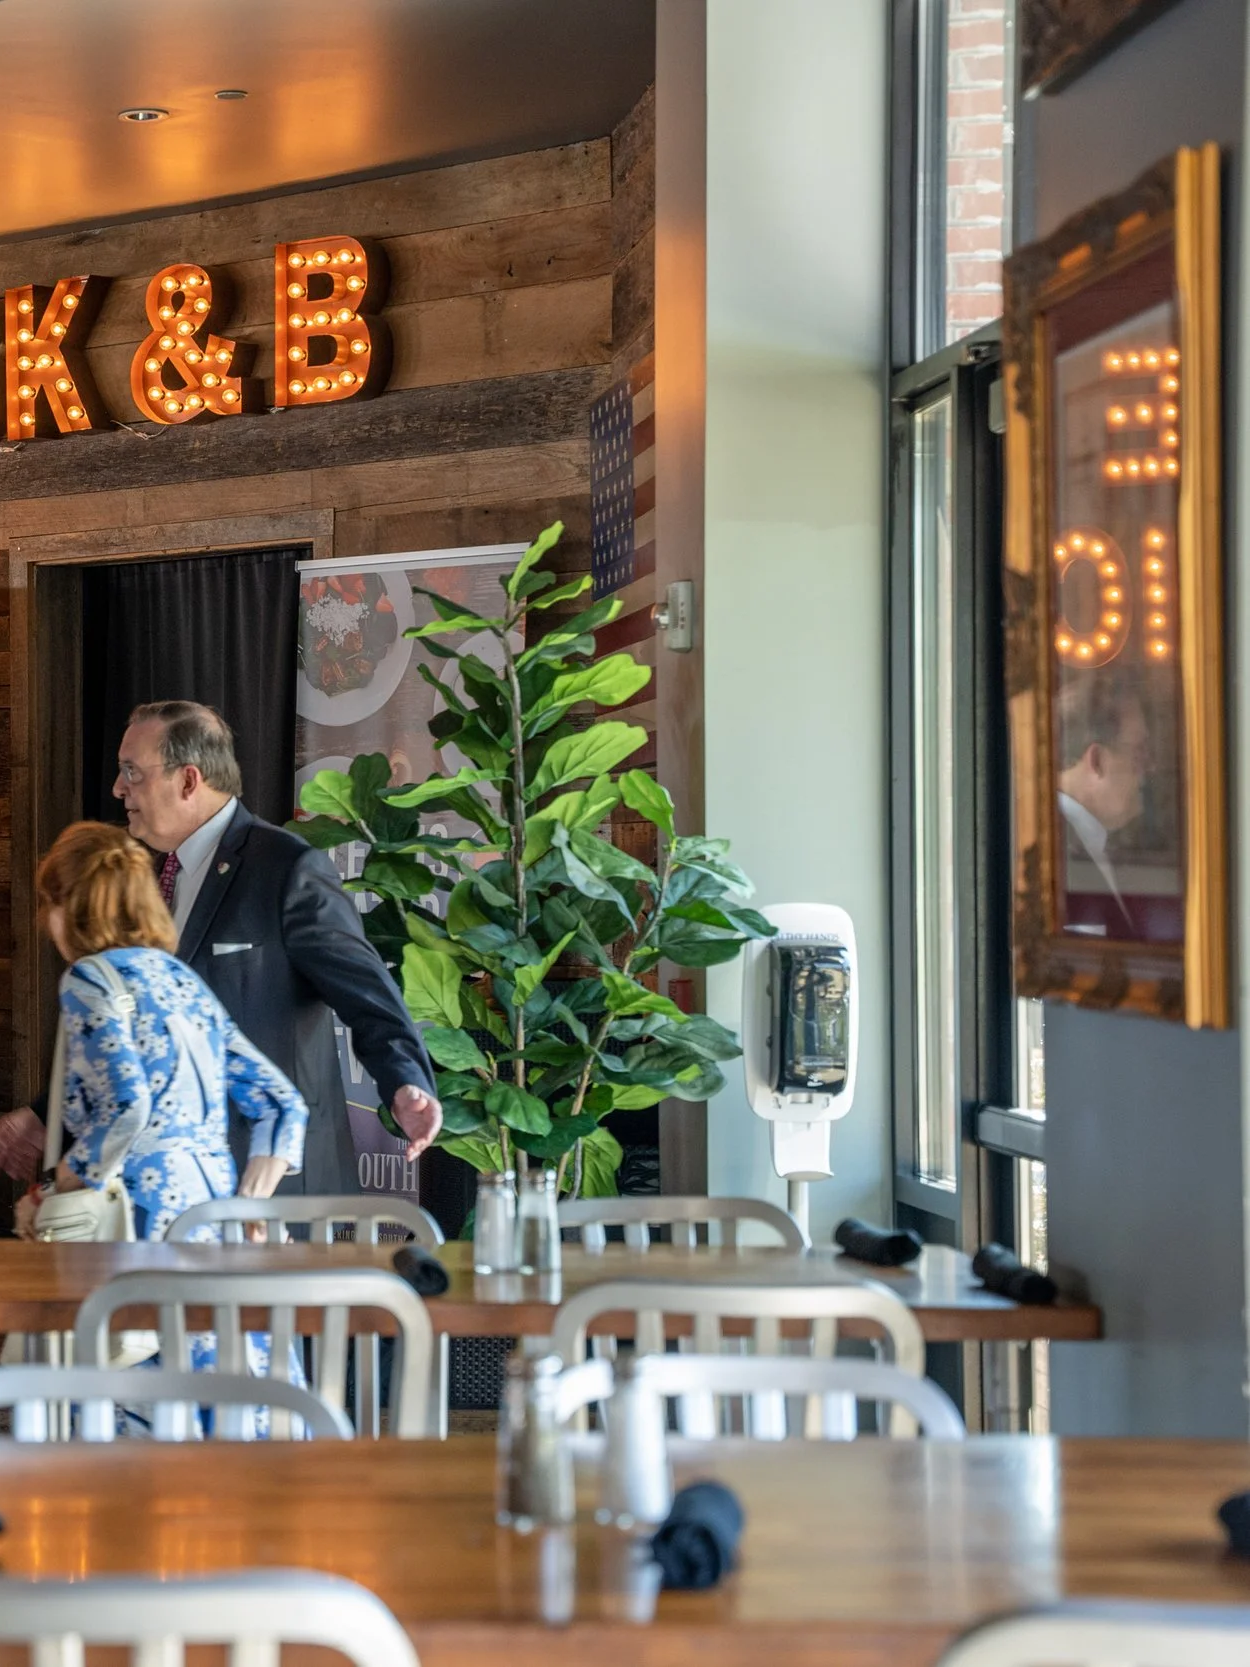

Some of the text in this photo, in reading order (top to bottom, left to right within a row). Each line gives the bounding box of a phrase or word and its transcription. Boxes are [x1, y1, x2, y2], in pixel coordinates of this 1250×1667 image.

[130, 263, 246, 425] &
[275, 235, 380, 408] B
[358, 1152, 418, 1192] OUTH
